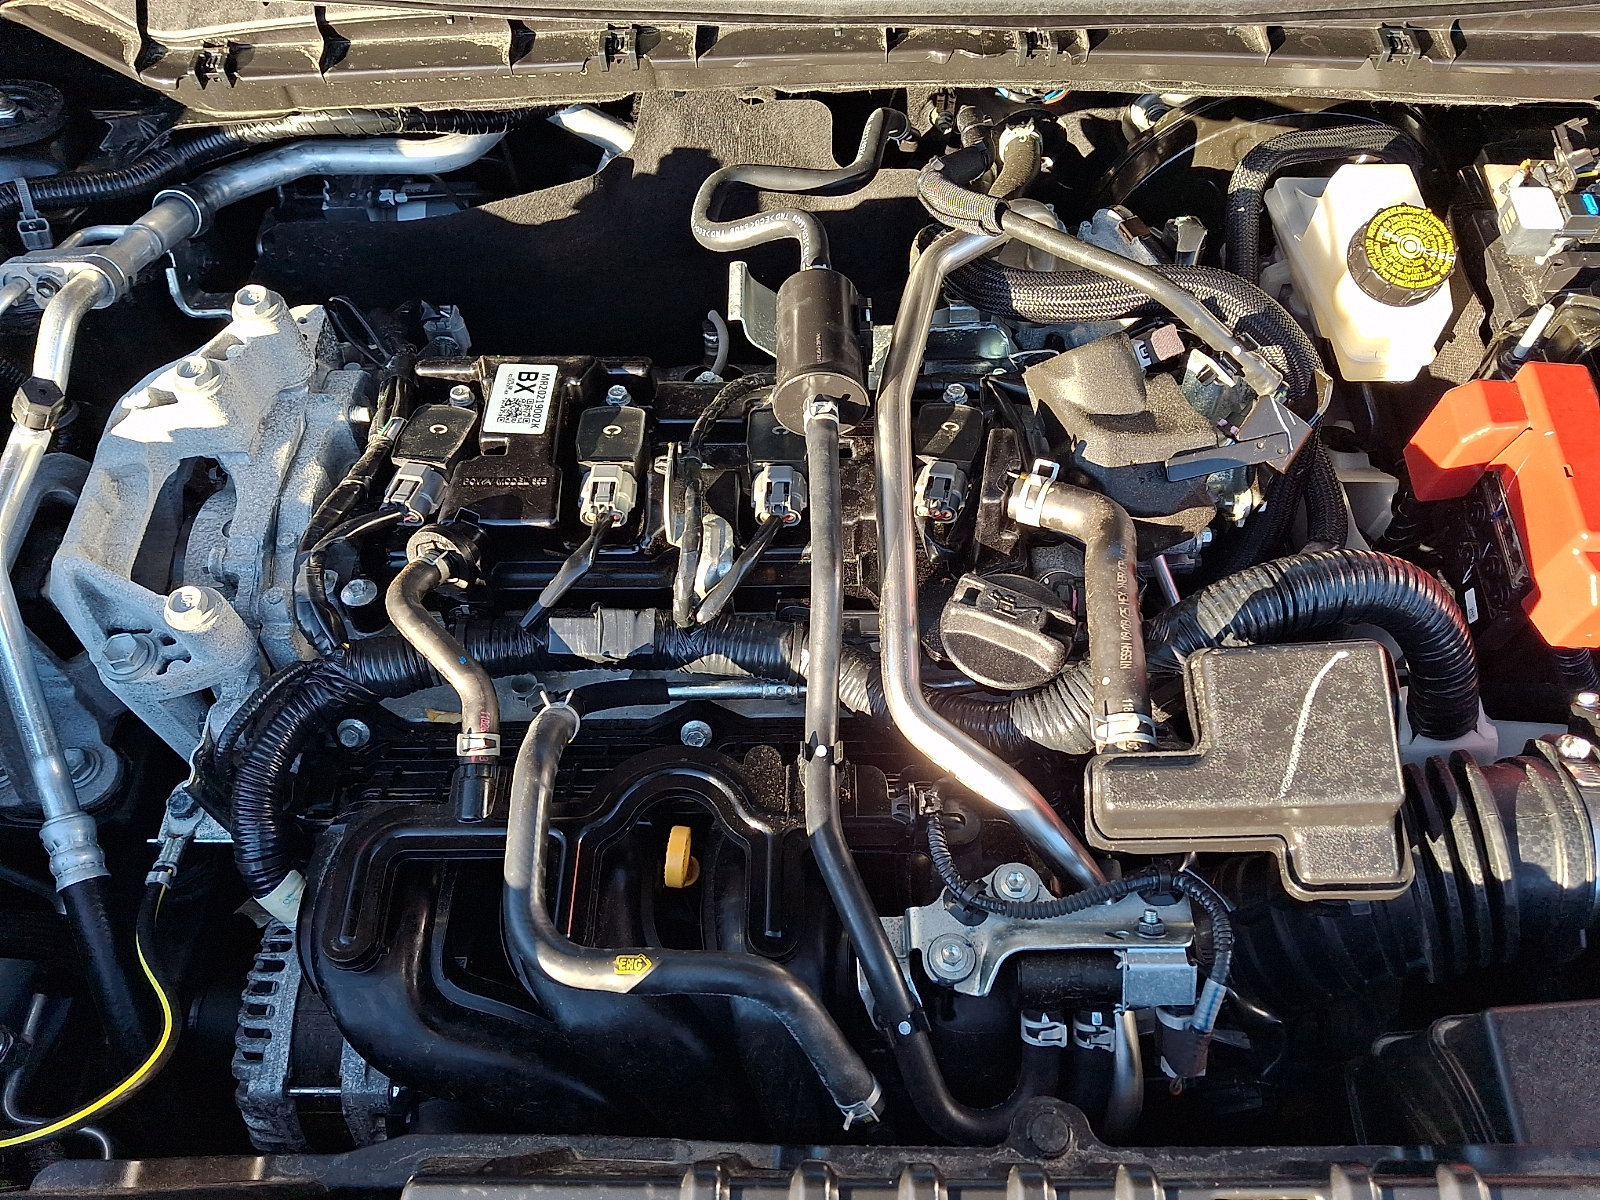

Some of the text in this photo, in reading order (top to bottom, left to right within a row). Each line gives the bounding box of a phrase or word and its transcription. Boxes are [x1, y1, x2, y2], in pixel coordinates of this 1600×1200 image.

[514, 371, 540, 394] BX
[1120, 642, 1133, 669] NISSAN
[618, 958, 643, 970] ENG
